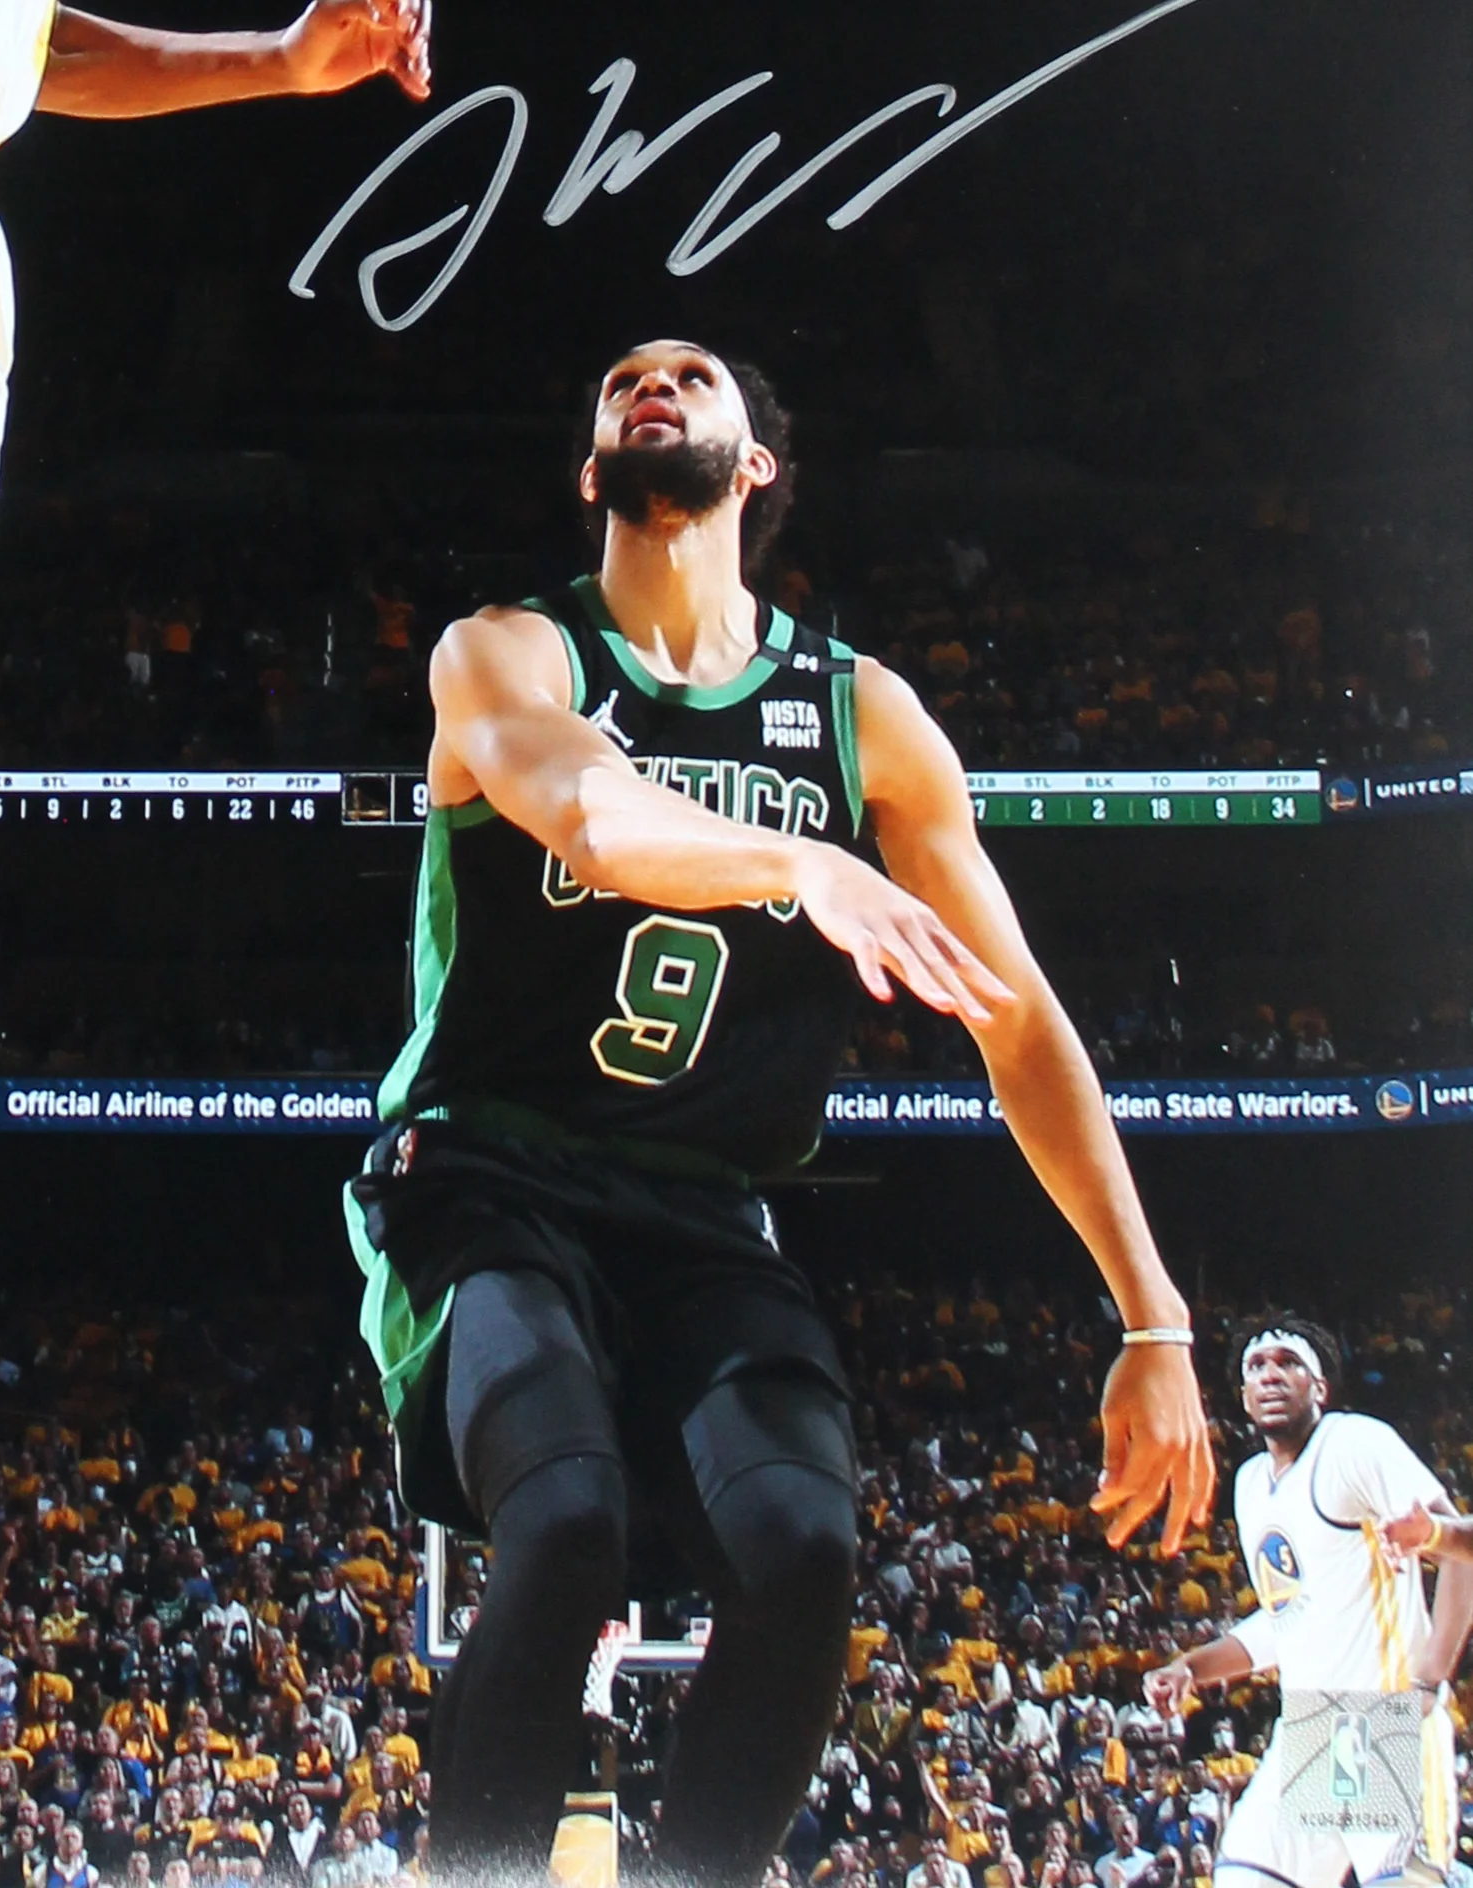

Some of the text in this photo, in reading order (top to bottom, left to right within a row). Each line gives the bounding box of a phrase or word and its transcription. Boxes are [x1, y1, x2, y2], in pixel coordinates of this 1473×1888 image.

[760, 700, 820, 726] VISTA
[762, 726, 822, 749] PRINT
[41, 776, 66, 788] STL
[102, 776, 130, 788] BLK
[168, 776, 189, 788] TO
[226, 776, 255, 788] POT
[285, 776, 321, 788] PITP
[1023, 776, 1051, 789] STL
[1084, 776, 1113, 788] BLK
[1150, 775, 1171, 788] TO
[1207, 775, 1237, 788] POT
[1266, 775, 1301, 787] PITP
[1377, 778, 1456, 798] UNITED
[48, 798, 59, 819] 9
[110, 798, 121, 819] 2
[173, 798, 184, 819] 6
[229, 799, 252, 819] 22
[291, 799, 314, 819] 46
[1031, 799, 1043, 819] 2
[1093, 799, 1105, 819] 2
[1151, 798, 1170, 819] 18
[1216, 798, 1228, 818] 9
[1272, 797, 1295, 818] 34
[590, 913, 729, 1086] 9
[8, 1090, 371, 1117] Official Airline of the Golden
[894, 1094, 982, 1118] Airline
[1167, 1093, 1232, 1117] State
[1238, 1091, 1358, 1116] Warriors.
